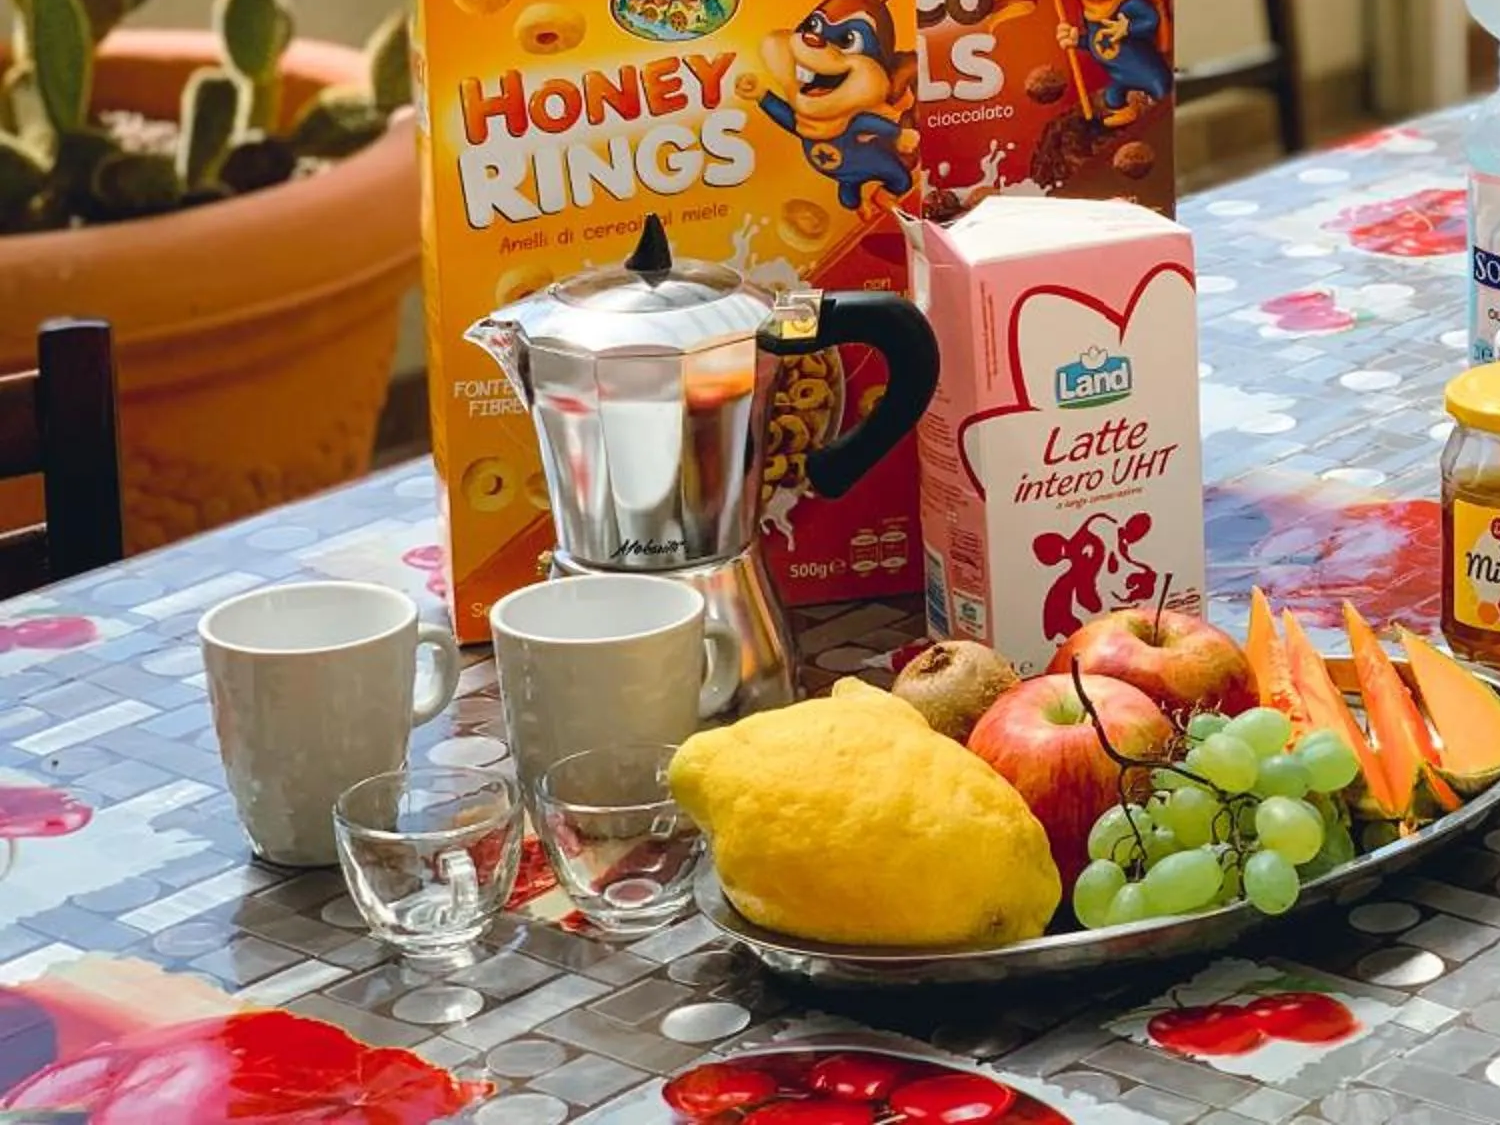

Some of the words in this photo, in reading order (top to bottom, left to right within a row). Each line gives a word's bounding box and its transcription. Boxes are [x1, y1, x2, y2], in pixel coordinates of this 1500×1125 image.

[917, 33, 1005, 102] LS
[459, 51, 737, 146] HONEY
[927, 104, 1015, 128] cioccolato
[458, 109, 756, 229] RINGS
[499, 234, 549, 255] Anelli
[557, 228, 574, 244] di
[681, 202, 729, 220] miele
[1059, 362, 1130, 401] Land
[1042, 417, 1149, 466] Latte
[1014, 467, 1103, 504] intero
[1111, 444, 1178, 485] UHT
[789, 562, 828, 580] 500g
